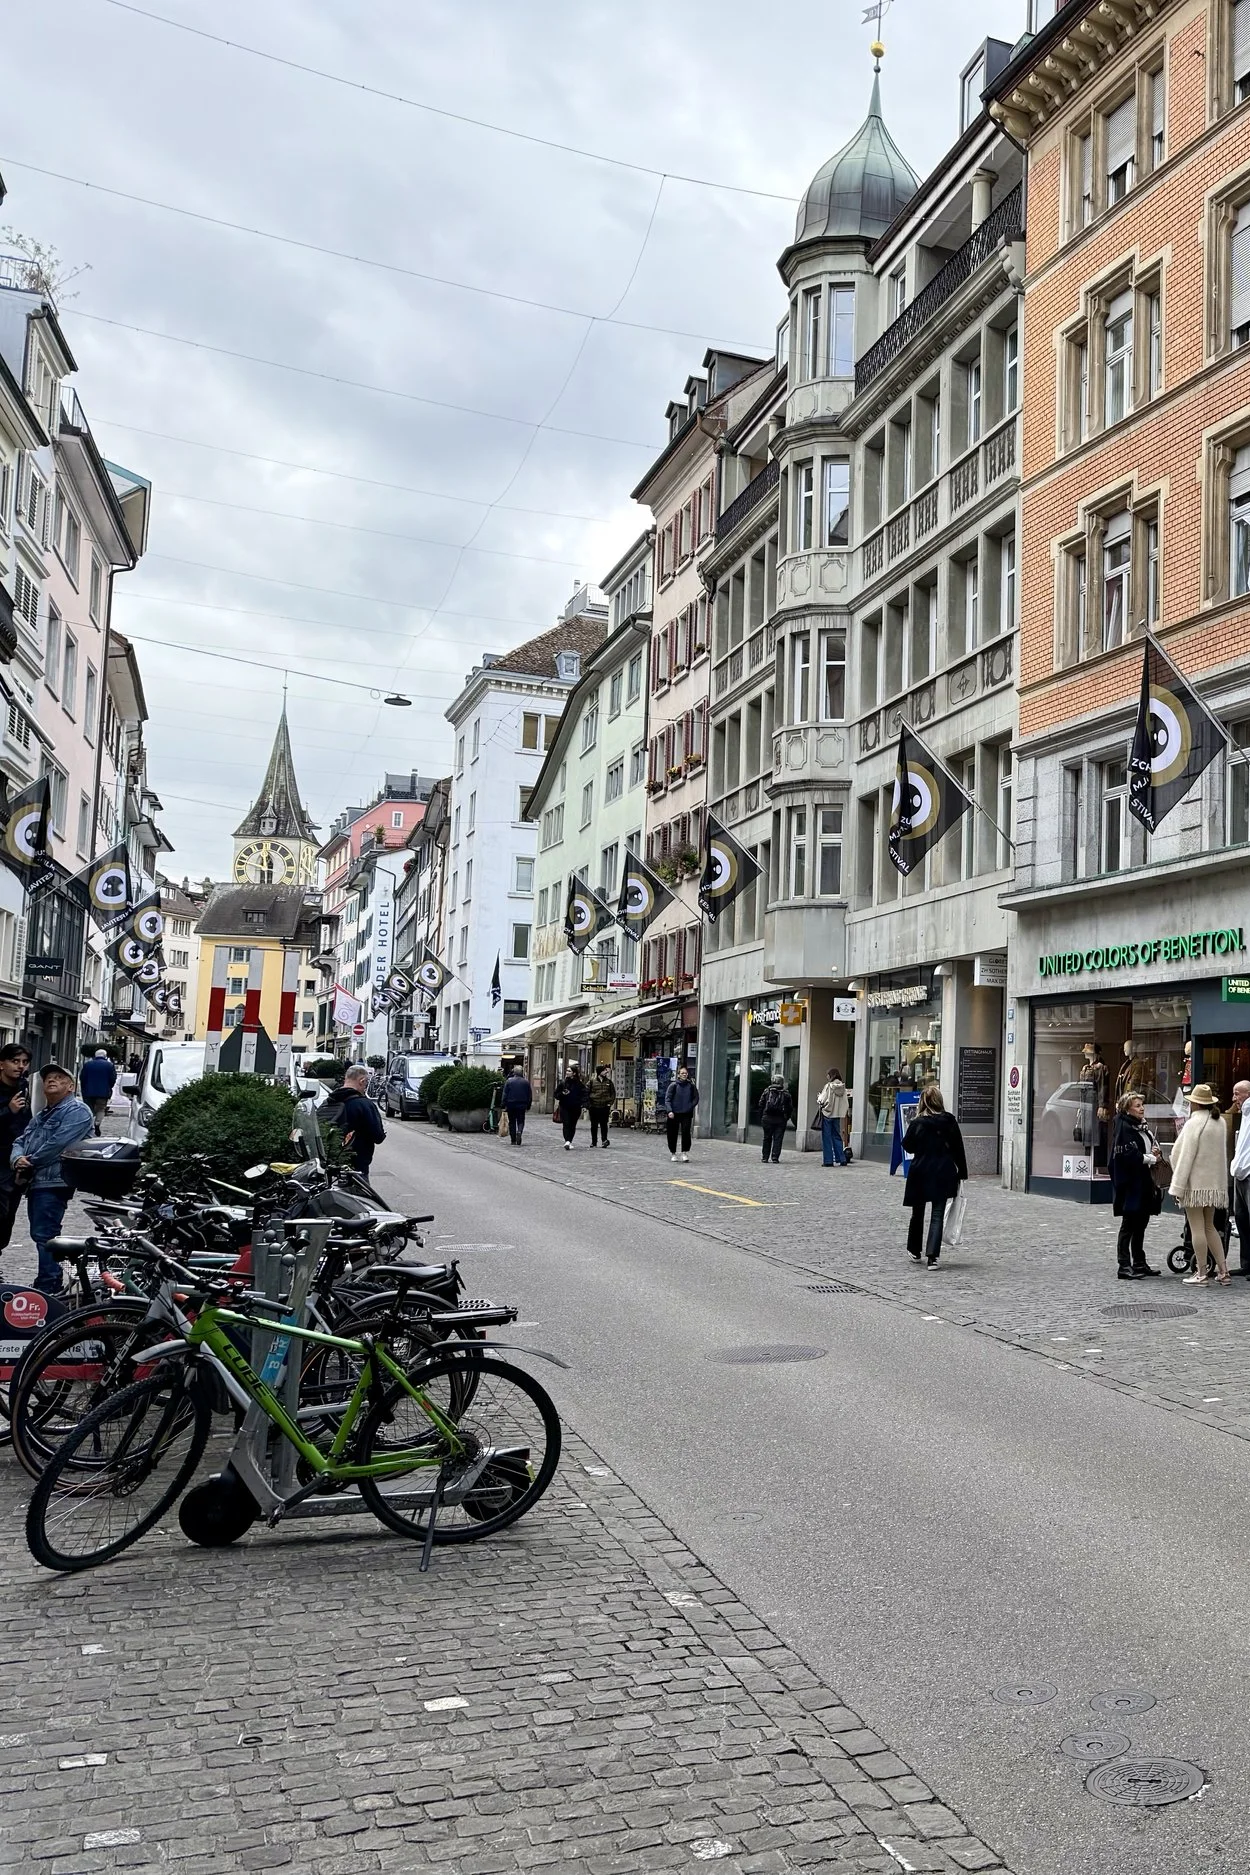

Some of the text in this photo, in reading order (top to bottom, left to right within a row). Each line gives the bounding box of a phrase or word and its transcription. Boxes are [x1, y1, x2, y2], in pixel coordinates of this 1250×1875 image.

[378, 901, 390, 947] HOTEL
[1039, 927, 1247, 976] UNITED COLORS OF BENETTON.
[1228, 979, 1249, 987] UNITED
[29, 1303, 41, 1311] Fr.
[100, 1330, 139, 1387] CUBE
[222, 1344, 267, 1397] CUBE
[268, 1338, 289, 1370] BIR
